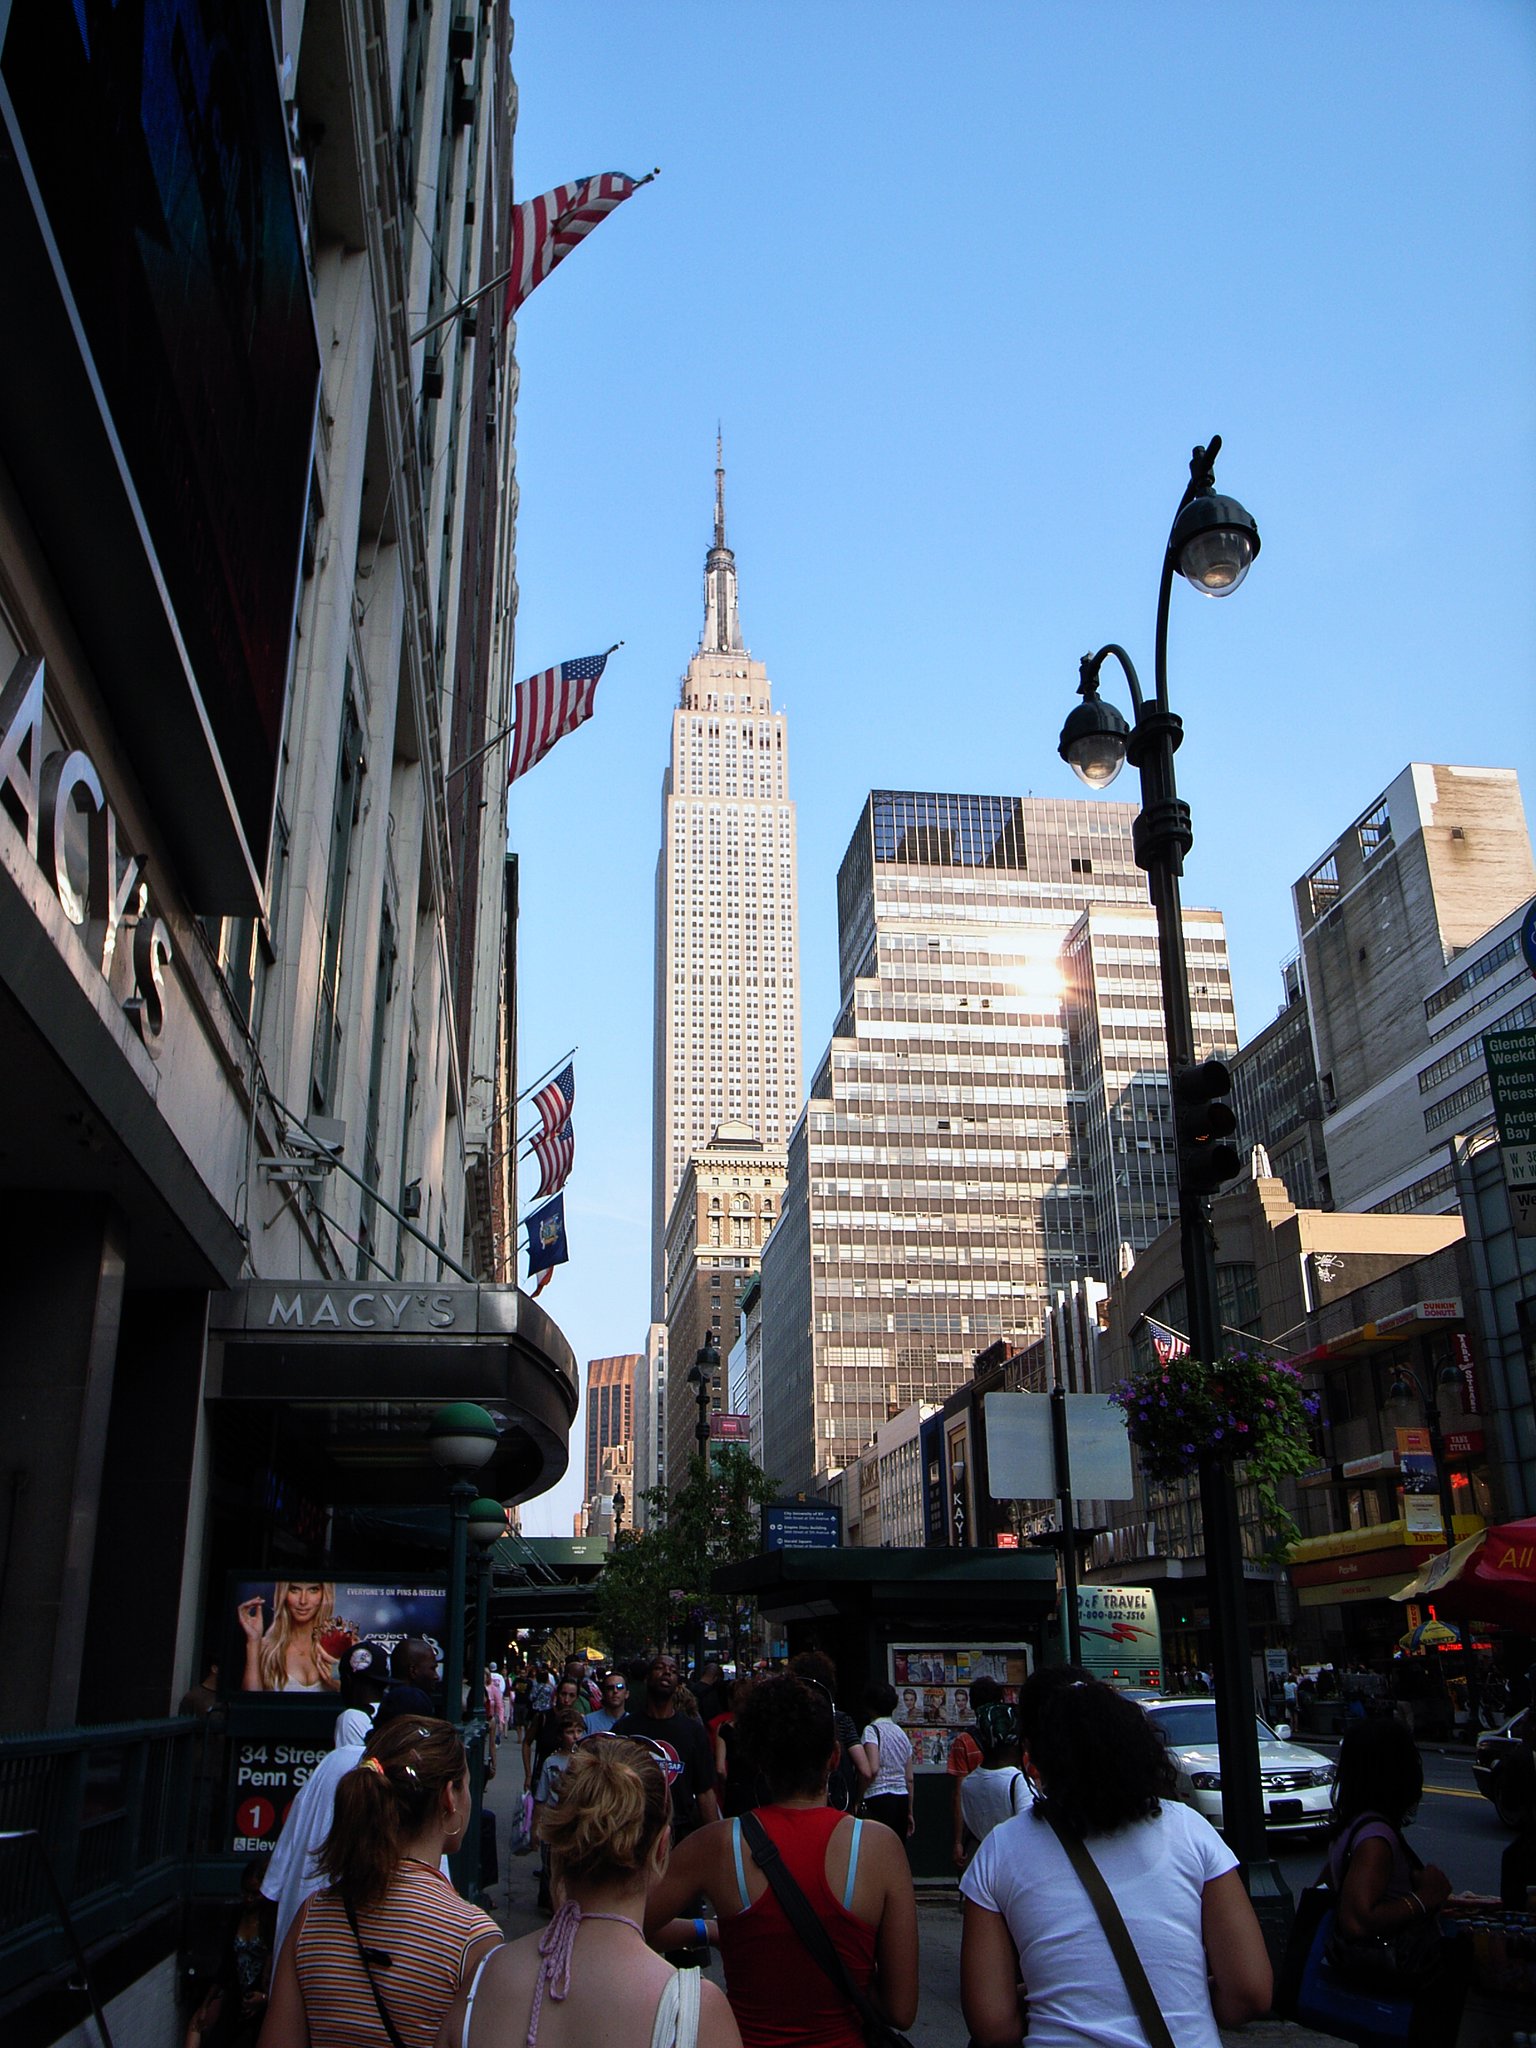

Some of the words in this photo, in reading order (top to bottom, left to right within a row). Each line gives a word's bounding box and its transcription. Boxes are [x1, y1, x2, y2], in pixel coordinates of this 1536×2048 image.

[1491, 1048, 1536, 1065] Weekd
[1497, 1071, 1535, 1087] Arden
[1506, 1127, 1530, 1141] Bay
[1512, 1166, 1525, 1179] NY
[1519, 1209, 1528, 1221] 7
[1423, 1302, 1457, 1310] DUNKIN'
[1497, 1546, 1535, 1569] All
[346, 1588, 384, 1596] EVERYONE'S
[418, 1589, 446, 1597] NEEDLES
[1103, 1595, 1148, 1609] TRAVEL
[363, 1632, 408, 1641] project
[240, 1745, 269, 1765] 34
[274, 1745, 328, 1765] Stree
[237, 1766, 287, 1787] Penn
[249, 1805, 261, 1829] 1
[246, 1838, 276, 1852] Elev
